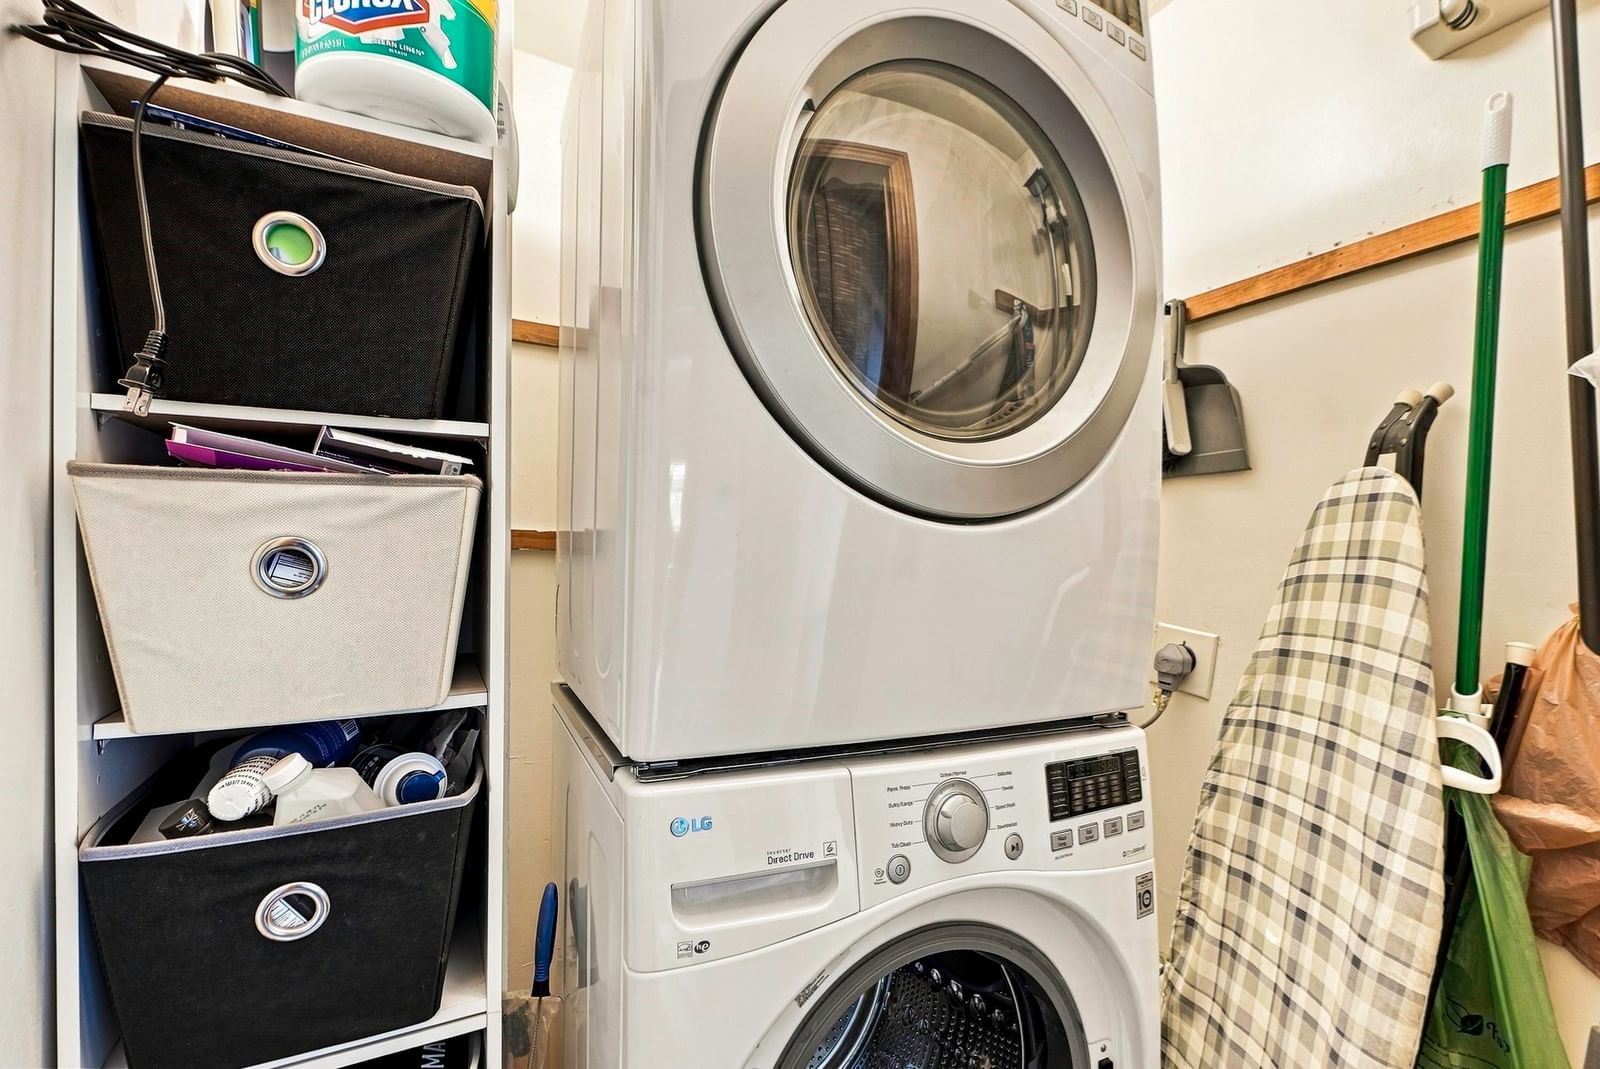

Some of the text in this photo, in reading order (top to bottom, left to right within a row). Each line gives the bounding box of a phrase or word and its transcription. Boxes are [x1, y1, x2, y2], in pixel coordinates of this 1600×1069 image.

[691, 816, 713, 832] LG
[767, 854, 792, 865] Direct
[793, 851, 815, 861] Drive
